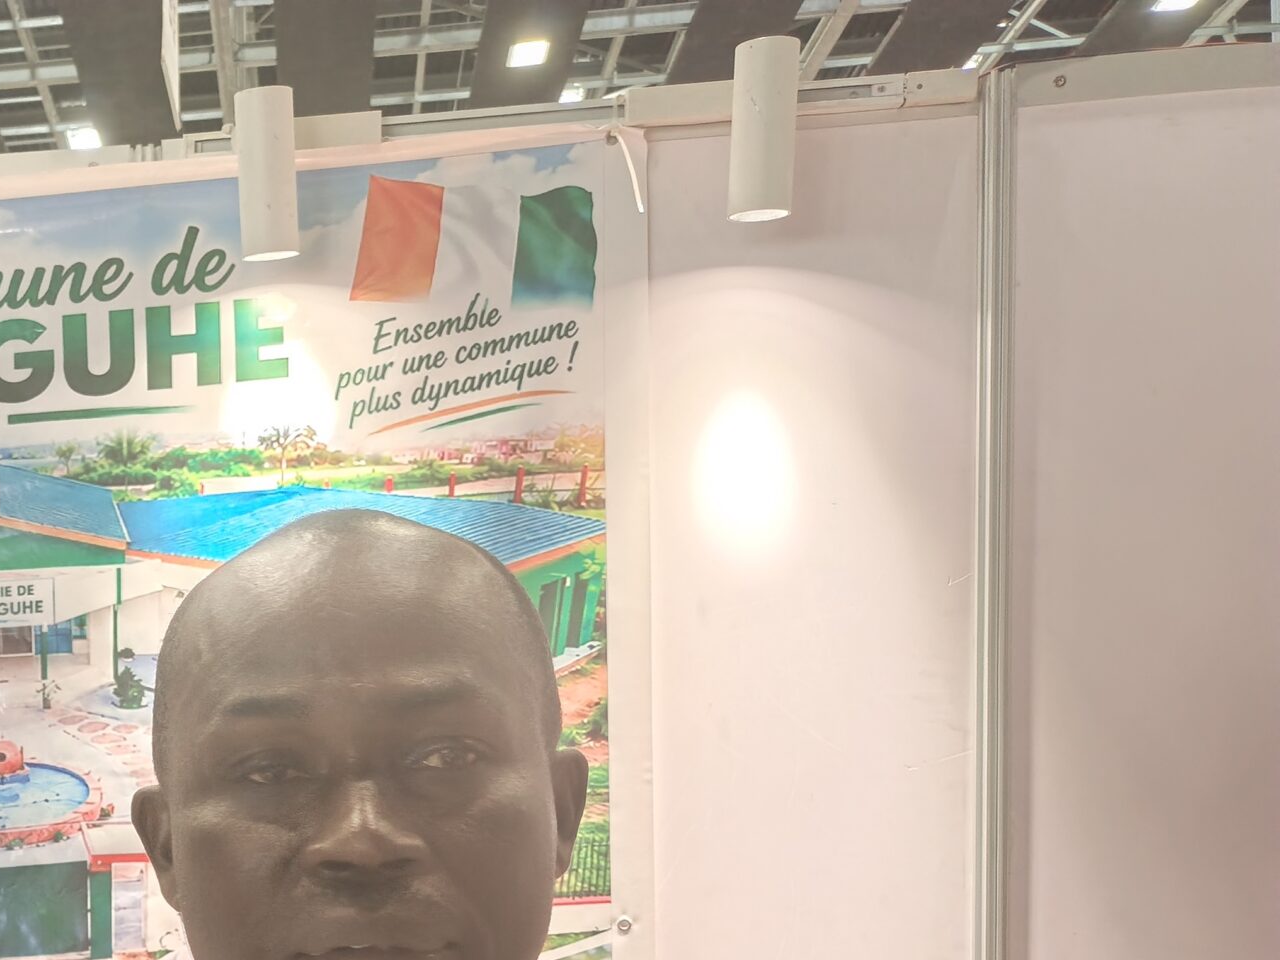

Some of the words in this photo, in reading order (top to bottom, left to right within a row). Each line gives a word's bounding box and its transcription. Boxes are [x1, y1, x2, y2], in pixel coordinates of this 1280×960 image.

[150, 225, 237, 296] de
[372, 292, 502, 355] Ensemble
[334, 359, 394, 402] pour
[402, 329, 448, 377] une
[455, 319, 580, 365] commune
[349, 386, 402, 429] plus
[410, 340, 559, 411] dynamique
[17, 584, 35, 597] DE
